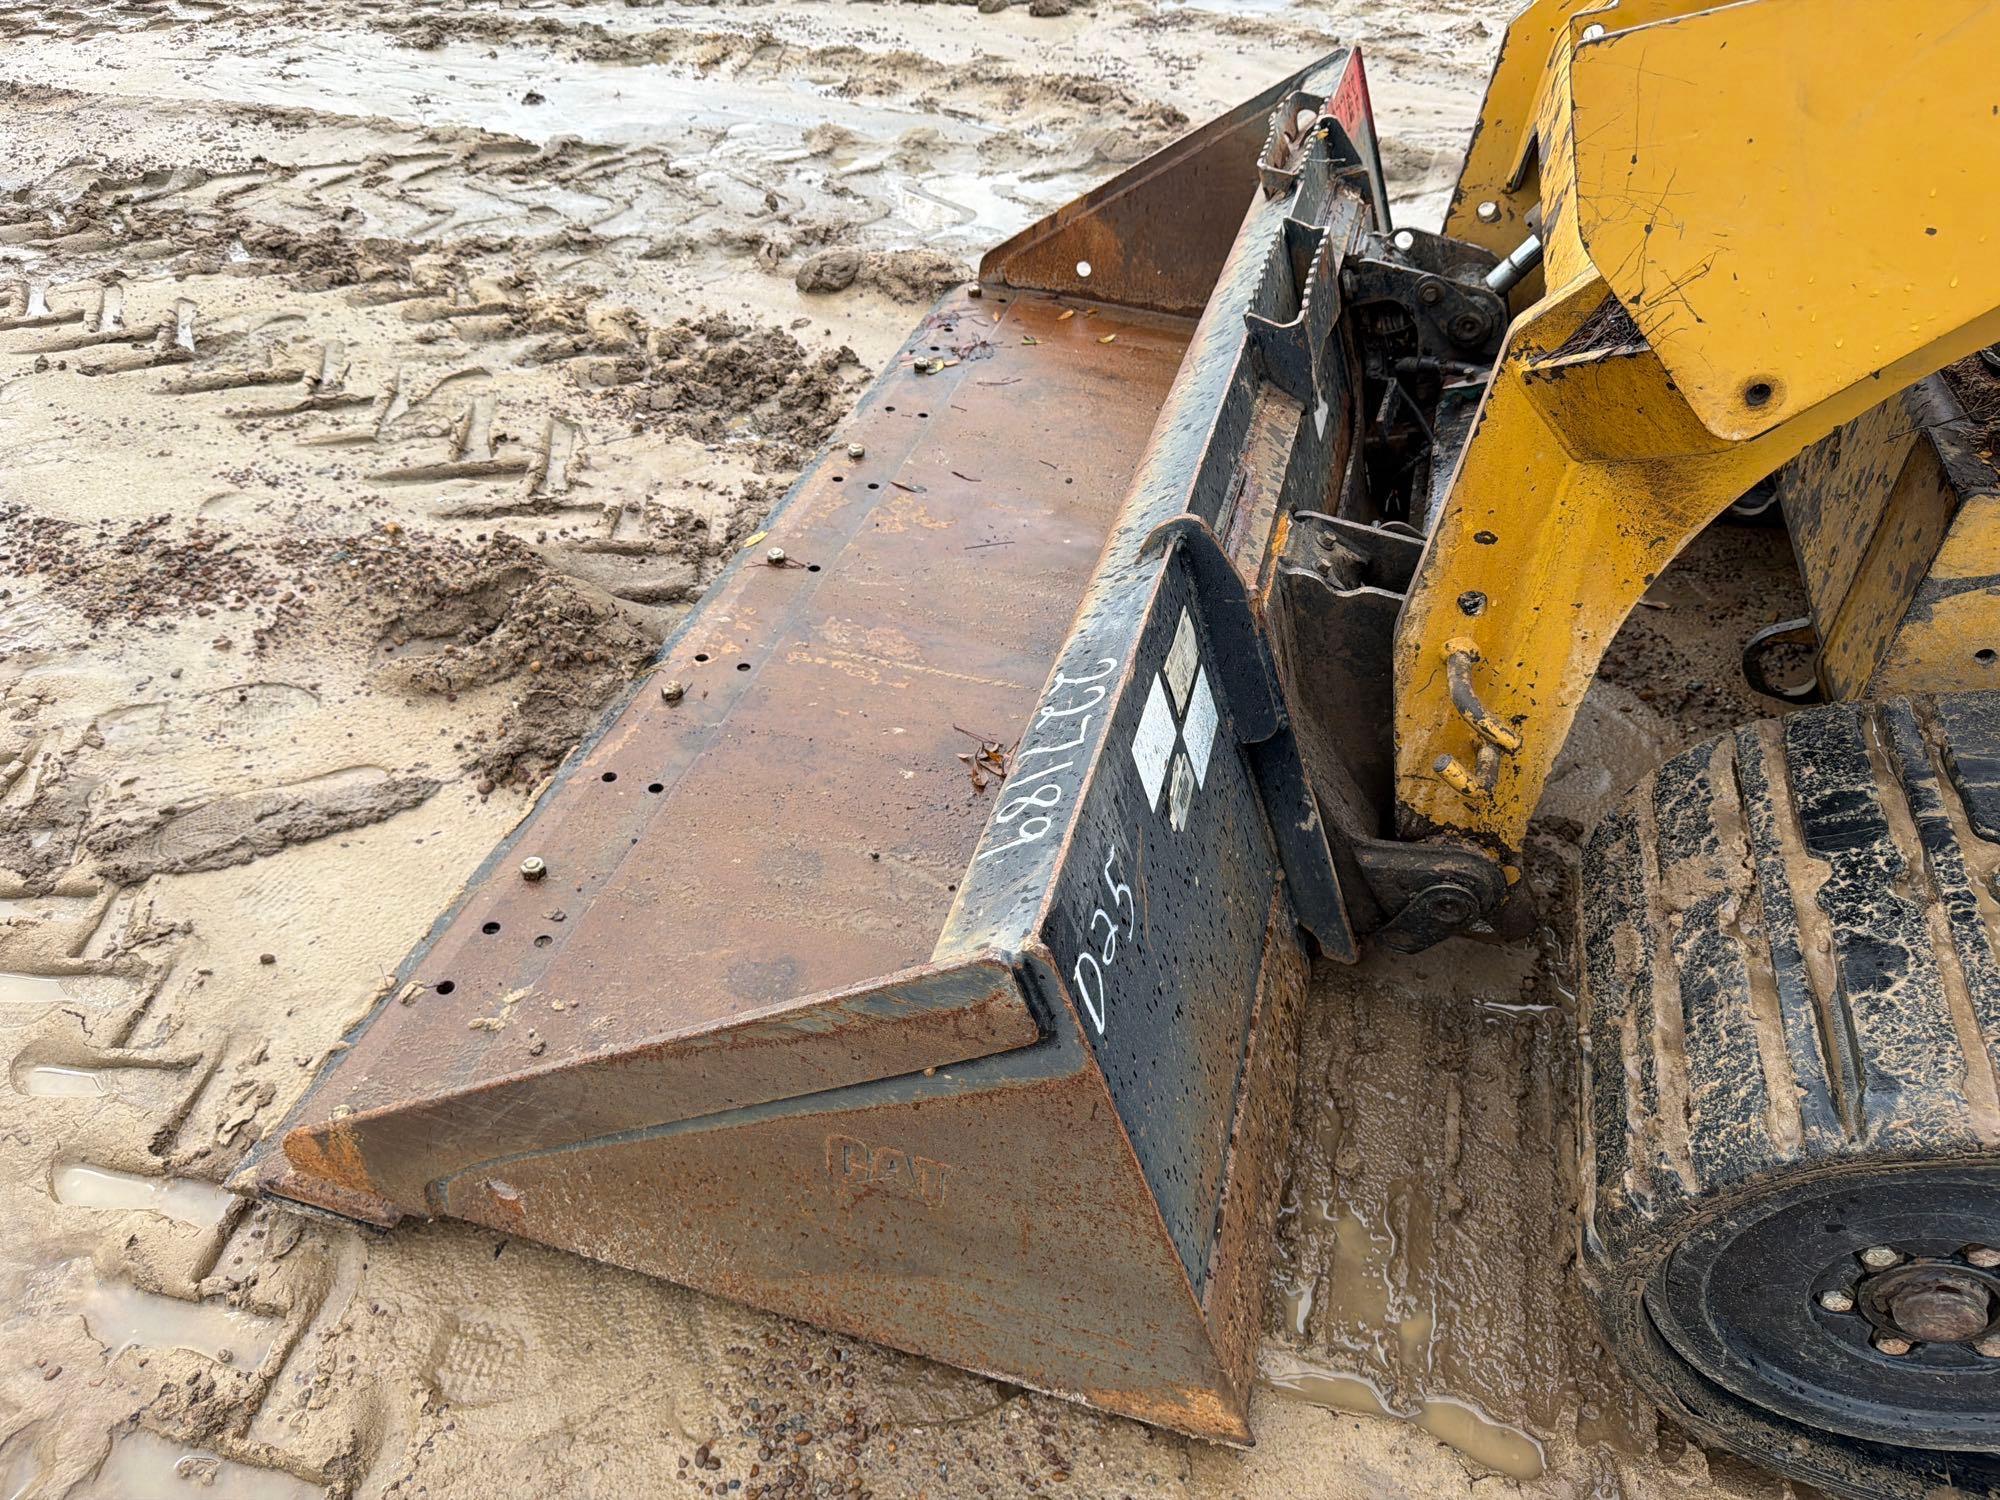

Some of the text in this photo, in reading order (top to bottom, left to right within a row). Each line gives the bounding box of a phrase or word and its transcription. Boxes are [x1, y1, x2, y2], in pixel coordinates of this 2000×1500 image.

[976, 656, 1119, 861] 227189
[1072, 843, 1135, 1036] D25
[825, 1134, 954, 1208] CAT
